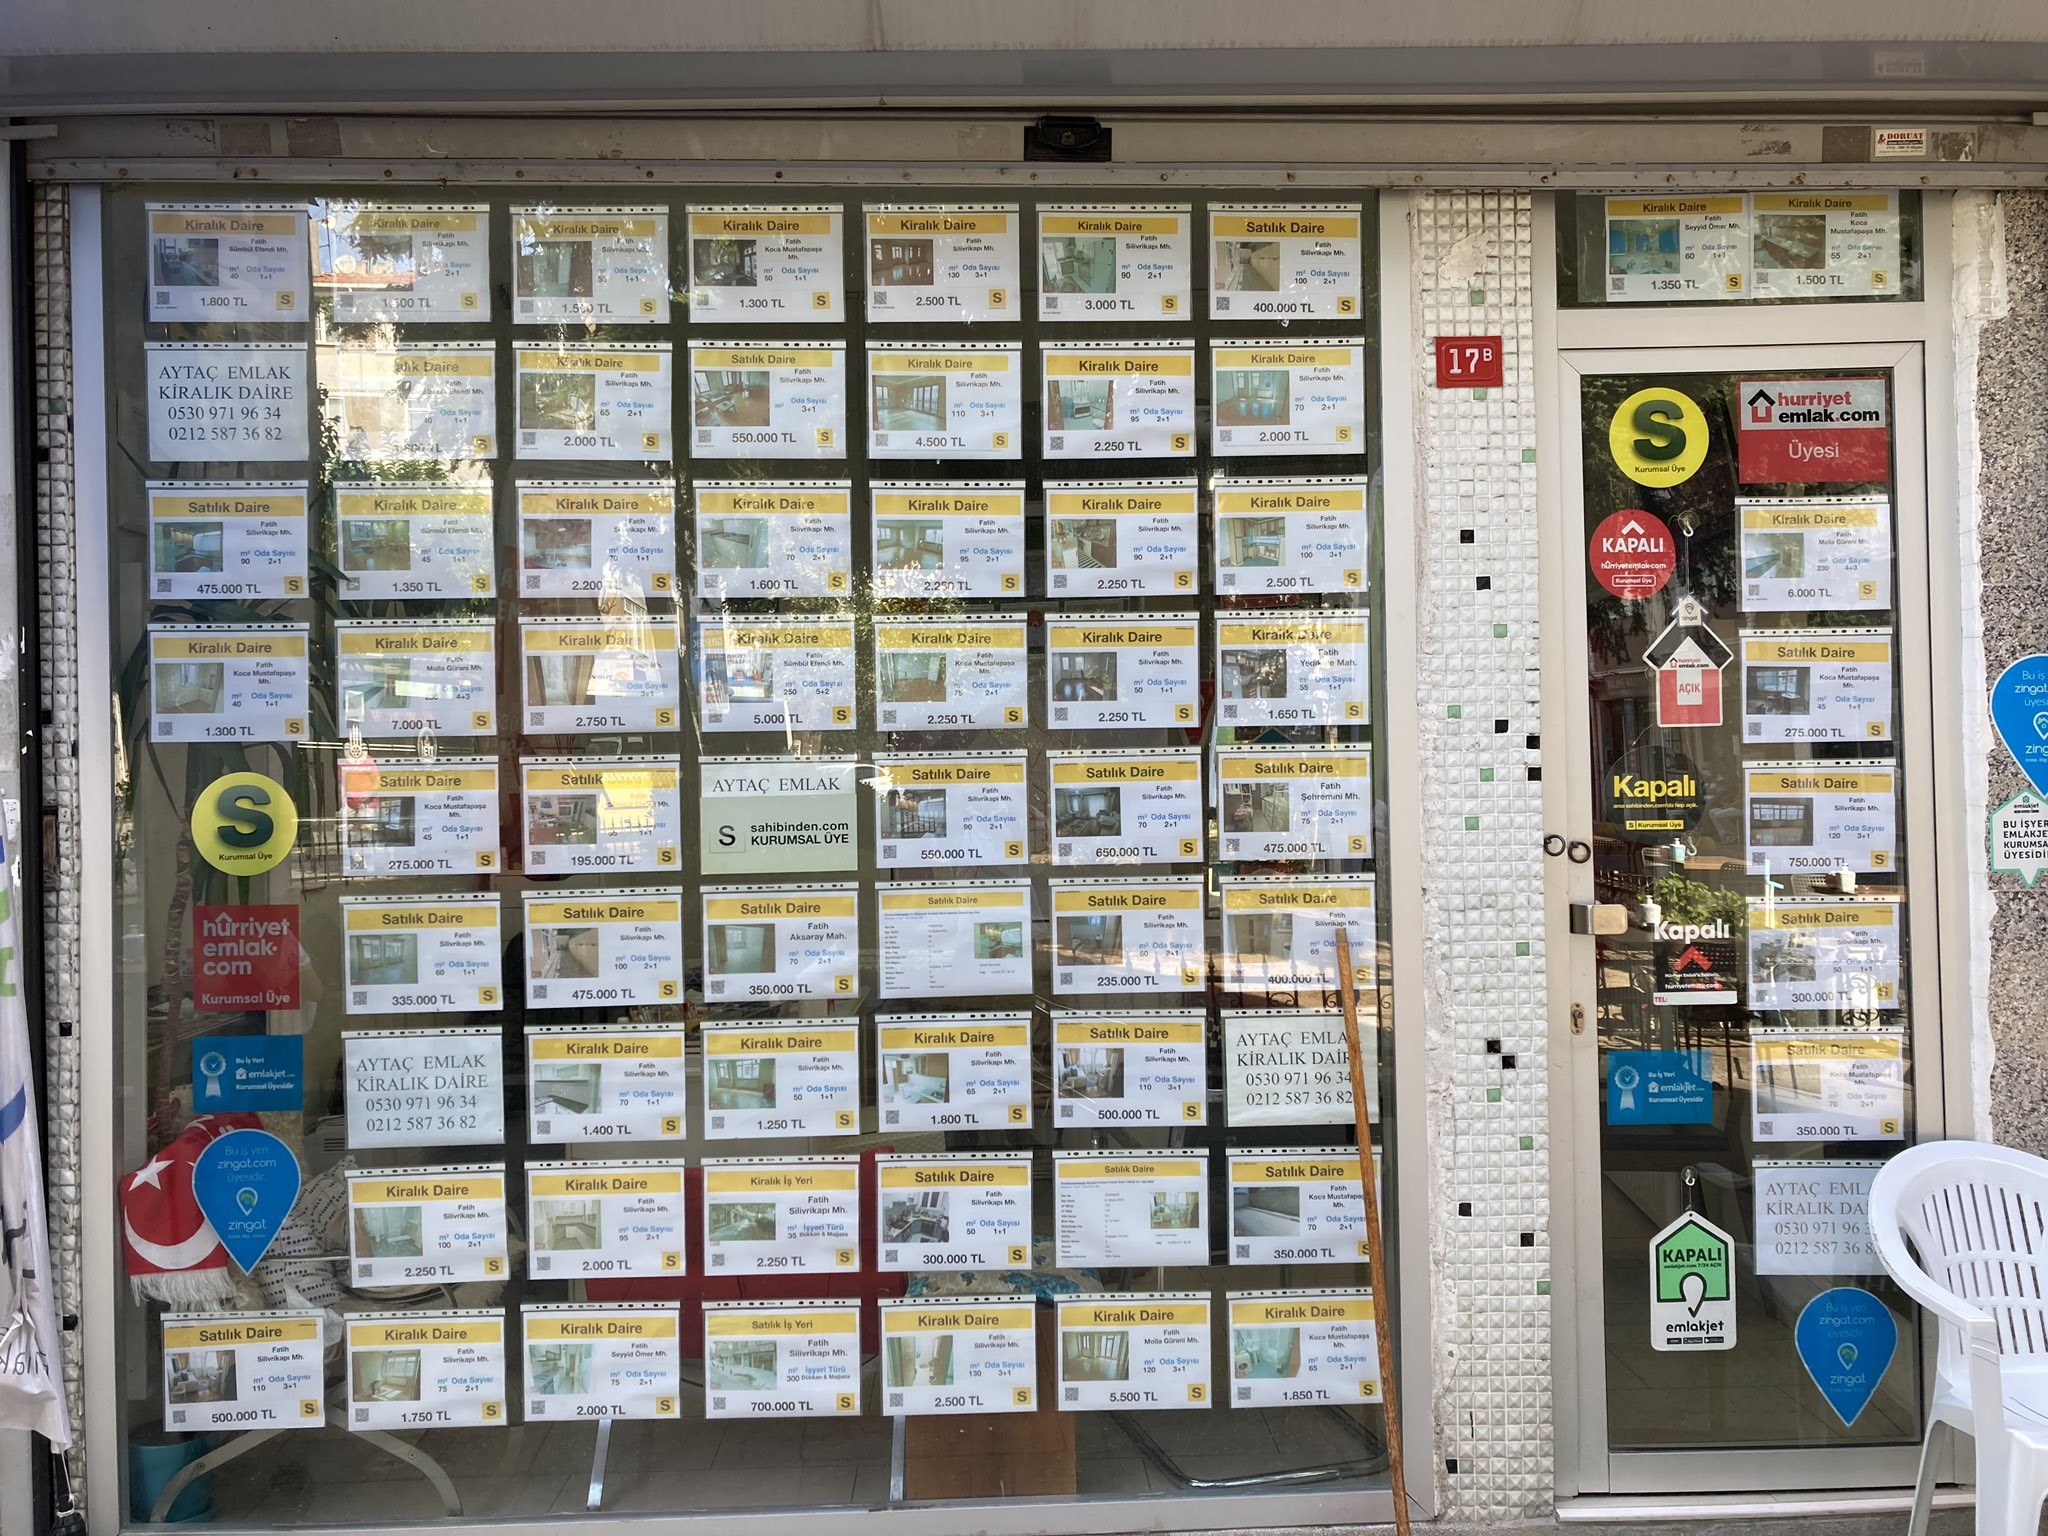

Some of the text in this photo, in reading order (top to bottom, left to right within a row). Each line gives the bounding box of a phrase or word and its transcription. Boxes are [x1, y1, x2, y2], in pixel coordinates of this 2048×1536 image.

[1643, 203, 1706, 212] Kiralık Daire
[186, 220, 264, 231] Kiralık Daire
[1246, 222, 1324, 233] Satılık Daire
[1652, 280, 1699, 289] 1.350 TL
[1797, 275, 1844, 284] 1.500 TL
[201, 297, 247, 306] 1.800 TL
[740, 299, 784, 308] 1.300 TL
[916, 297, 961, 305] 2.500 TL
[1086, 300, 1134, 309] 3.000 TL
[1254, 303, 1314, 312] 400.000 TL
[159, 366, 290, 381] AYTAÇ EMLAK
[160, 384, 292, 399] KİRALIK DAİRE
[1778, 392, 1851, 408] hurriyet
[168, 407, 281, 419] 0530 971 96 34
[1779, 409, 1879, 423] emlak.com
[169, 427, 282, 440] 0212 587 36 82
[1632, 400, 1686, 460] S
[732, 433, 796, 442] 550.000 TL
[916, 437, 965, 446] 4.500 TL
[1095, 442, 1142, 451] 2.250 TL
[1789, 439, 1838, 459] Üyesi
[1672, 464, 1685, 473] Üye
[1603, 538, 1663, 553] KAPALI
[1267, 577, 1314, 587] 2.500 TL
[197, 584, 261, 593] 475.000 TL
[1788, 589, 1832, 597] 6.000 TL
[1778, 647, 1855, 657] Satılık Daire
[1679, 683, 1700, 695] AÇIK
[576, 717, 625, 726] 2.750 TL
[1099, 712, 1146, 721] 2.250 TL
[392, 720, 441, 729] 7.000 TL
[713, 778, 840, 794] AYTAÇ EMLAK
[1614, 775, 1695, 802] Kapalı
[217, 785, 274, 847] S
[751, 822, 848, 833] sahibinden.com
[1670, 821, 1681, 829] Üye
[719, 826, 735, 846] S
[752, 832, 848, 845] KURUMSAL ÜYE
[258, 851, 272, 860] Üye
[1096, 847, 1157, 857] 650.000 TL
[1789, 858, 1831, 867] 750.000
[1654, 919, 1729, 944] Kapalı
[203, 961, 251, 976] com
[572, 989, 635, 999] 475.000 TL
[750, 984, 812, 995] 350.000 TL
[202, 990, 290, 1005] Kurumsal Üye
[1172, 1076, 1195, 1084] Sayısı
[1247, 1091, 1352, 1105] 0212 587 36 82
[1099, 1110, 1160, 1119] 500.000 TL
[583, 1125, 631, 1135] 1.400 TL
[1797, 1126, 1857, 1135] 350.000 TL
[218, 1158, 276, 1171] zingat.com
[751, 1177, 780, 1185] Kiralık
[784, 1175, 792, 1186] İş
[789, 1207, 827, 1215] Silivrikapı
[229, 1219, 265, 1232] zingat
[804, 1224, 824, 1232] İşyeri
[1274, 1248, 1335, 1258] 350.000 TL
[1663, 1248, 1721, 1262] KAPALI
[923, 1254, 985, 1264] 300.000 TL
[405, 1266, 454, 1277] 2.250 TL
[1819, 1316, 1874, 1327] zingat.com
[1666, 1320, 1724, 1334] emlakjet
[200, 1327, 282, 1341] Satılık Daire
[1830, 1374, 1865, 1386] zingat
[1110, 1392, 1158, 1402] 5.500 TL
[1283, 1390, 1330, 1400] 1.850 TL
[751, 1402, 813, 1411] 700.000 TL
[935, 1396, 983, 1407] 2.500 TL
